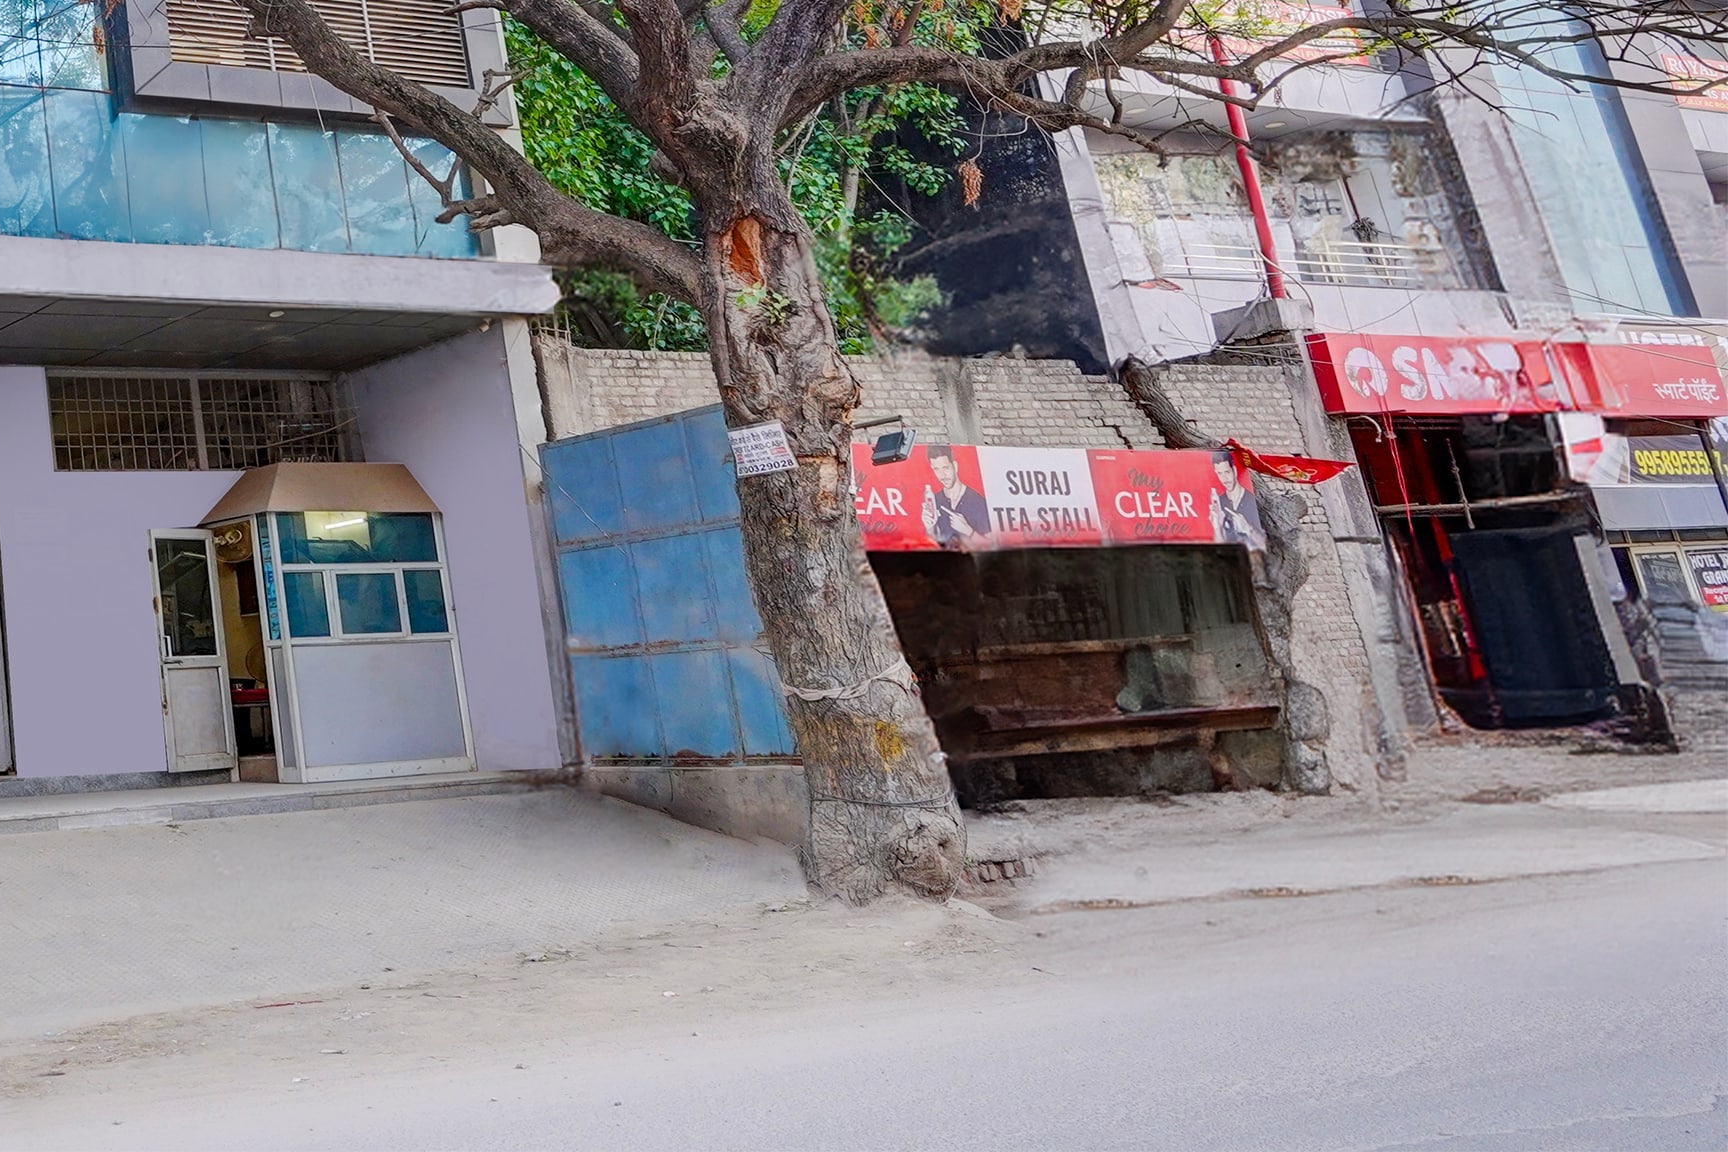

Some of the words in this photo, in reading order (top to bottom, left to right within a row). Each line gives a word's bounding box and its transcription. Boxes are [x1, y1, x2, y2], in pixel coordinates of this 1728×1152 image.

[1005, 470, 1072, 496] SURAJ
[855, 486, 908, 516] EAR
[1114, 490, 1198, 518] CLEAR
[993, 507, 1032, 532] TEA
[1037, 507, 1097, 532] STALL
[1689, 554, 1721, 569] HOTEL
